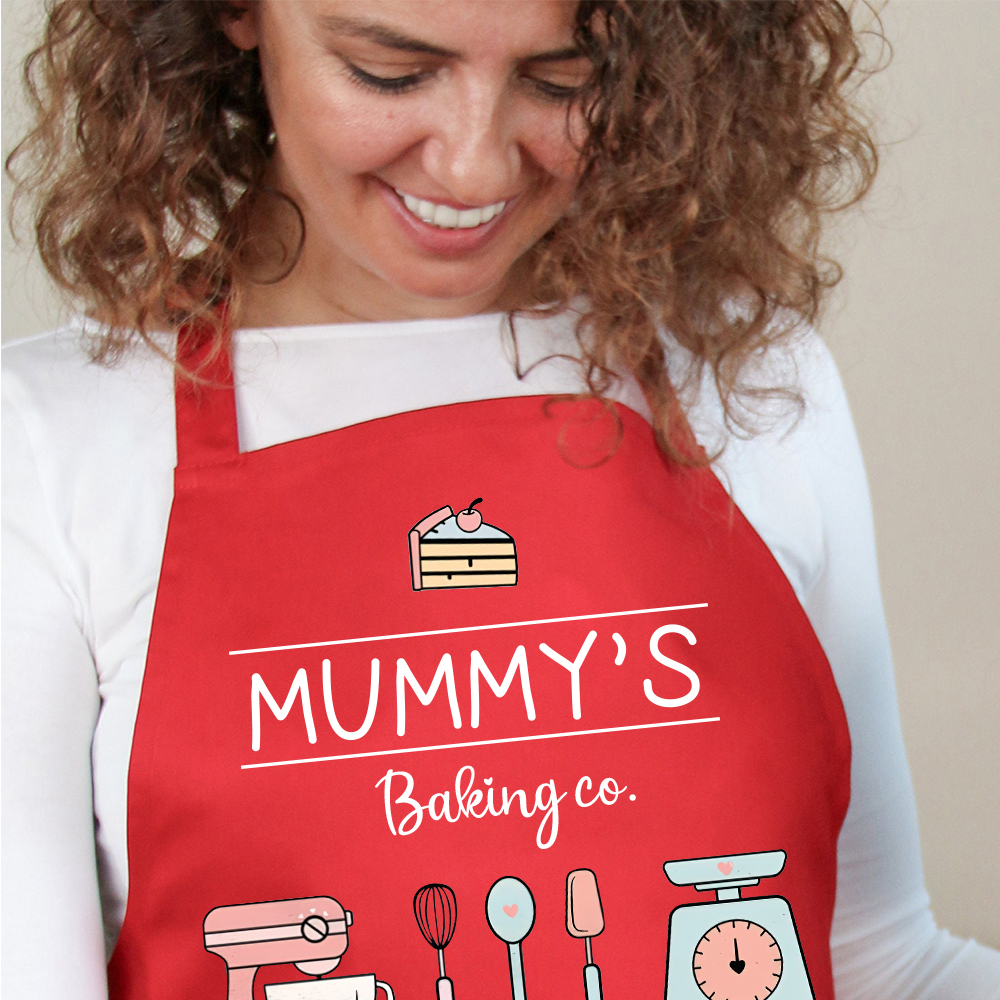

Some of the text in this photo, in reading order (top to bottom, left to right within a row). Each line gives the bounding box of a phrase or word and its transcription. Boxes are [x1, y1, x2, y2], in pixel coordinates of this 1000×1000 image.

[250, 623, 701, 752] MUMMY'S
[374, 765, 637, 850] Baking co.
